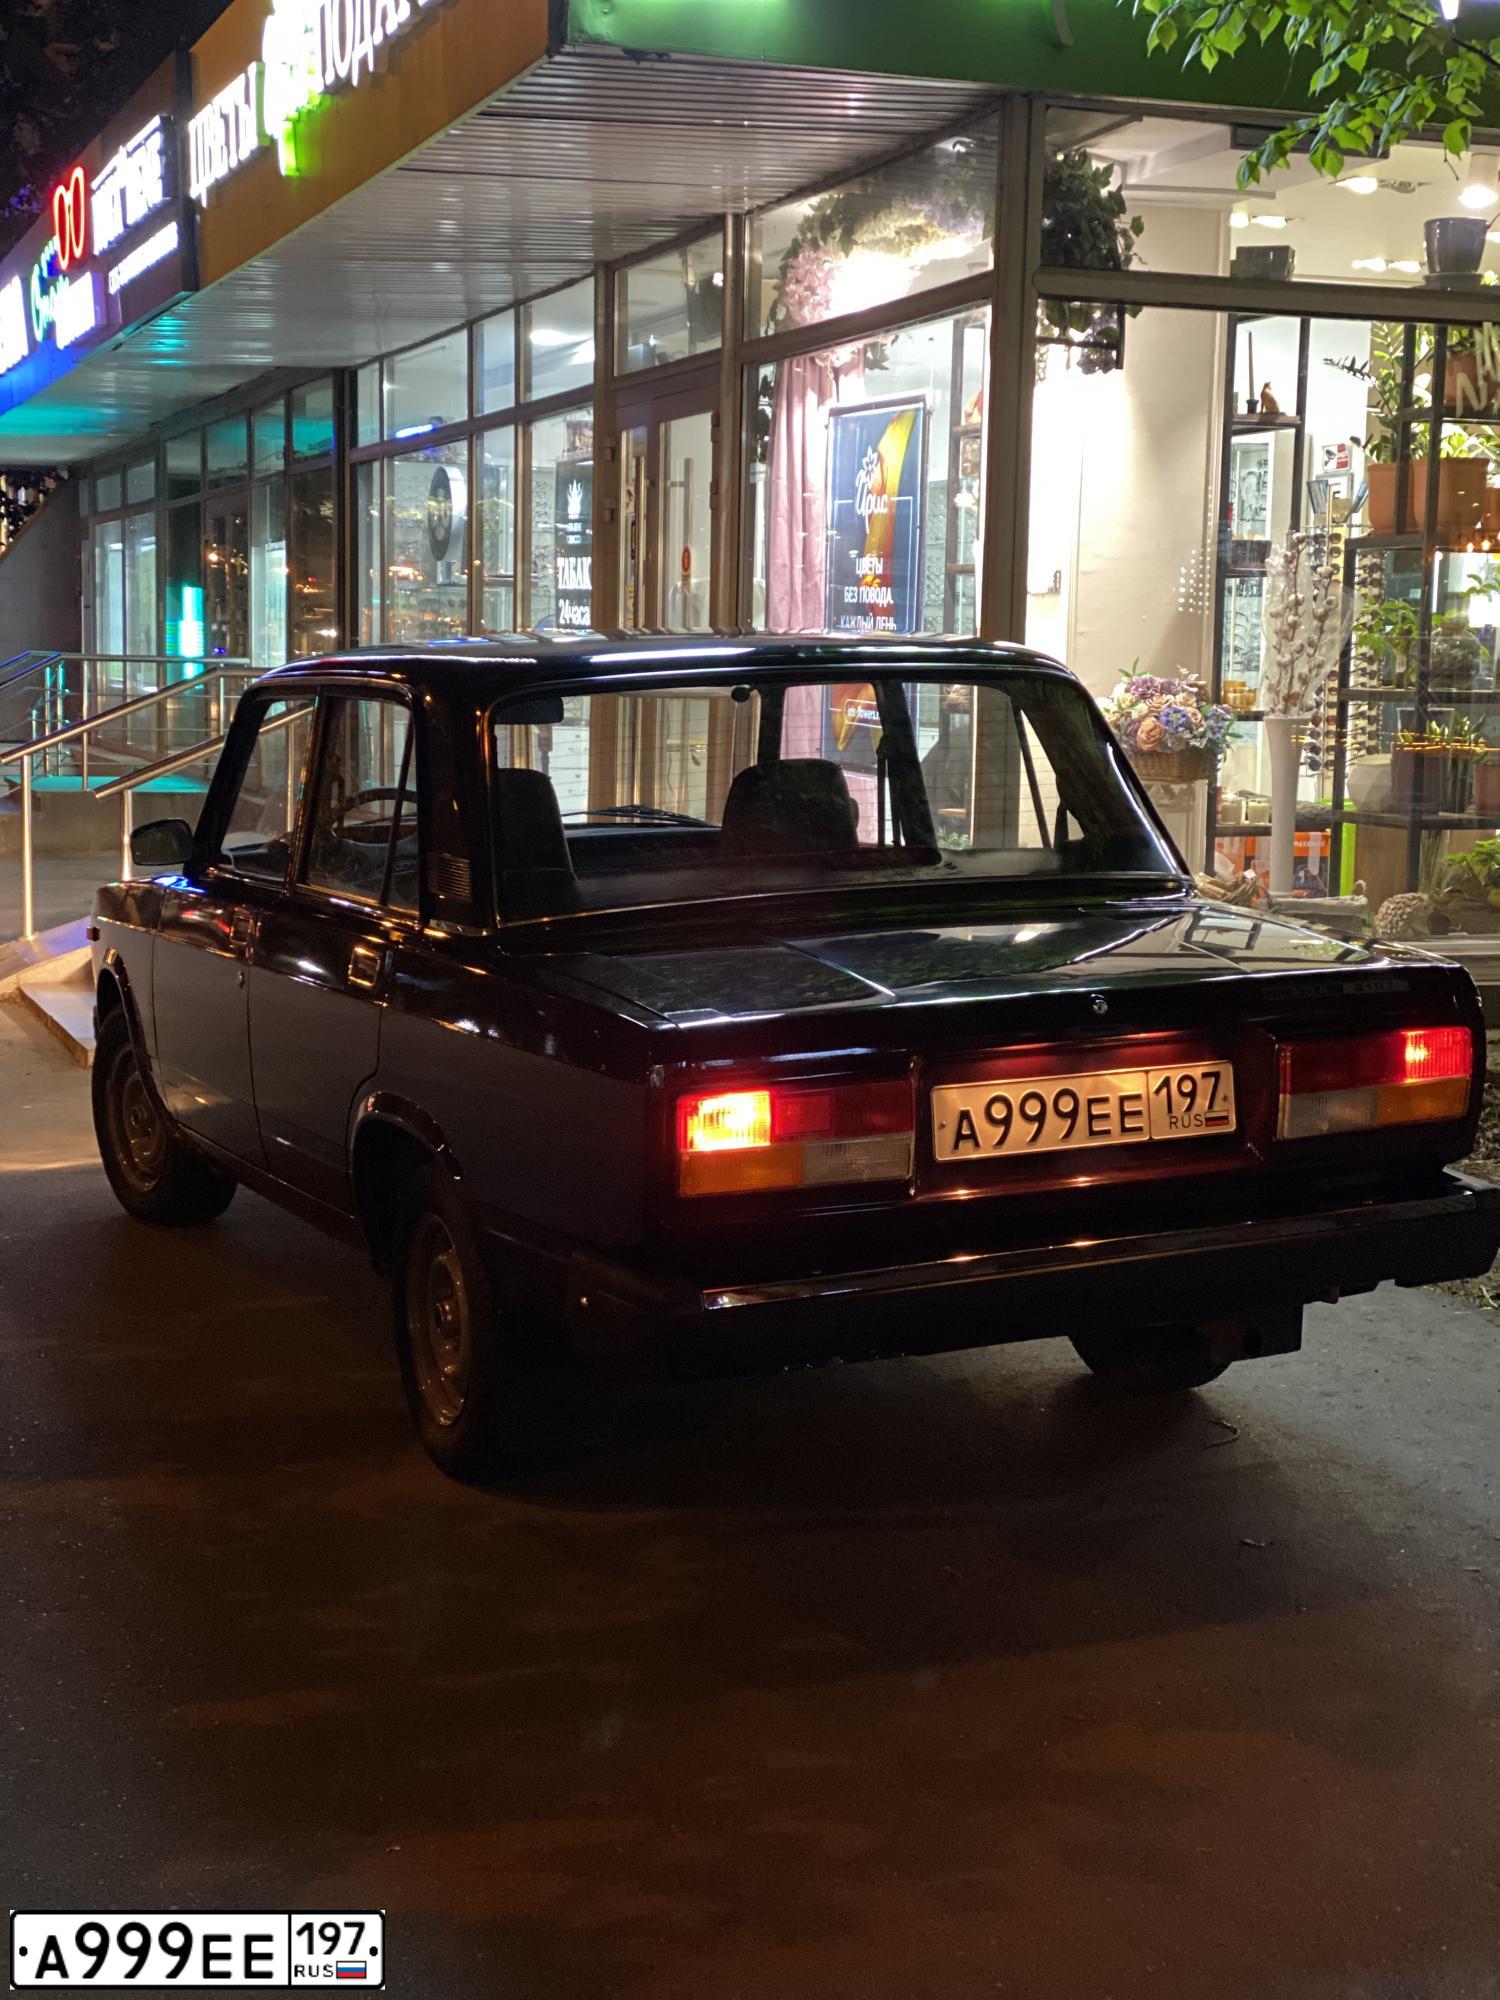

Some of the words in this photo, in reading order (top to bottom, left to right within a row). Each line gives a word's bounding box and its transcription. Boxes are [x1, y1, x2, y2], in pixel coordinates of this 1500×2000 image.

[188, 61, 258, 208] ЦВЕТЫ
[856, 468, 888, 534] Ирис
[557, 556, 592, 590] ТАБАК
[855, 557, 884, 577] ЦВЕТЫ
[844, 586, 858, 603] БЕЗ
[1152, 1071, 1221, 1114] 197
[1168, 1114, 1204, 1130] RUS
